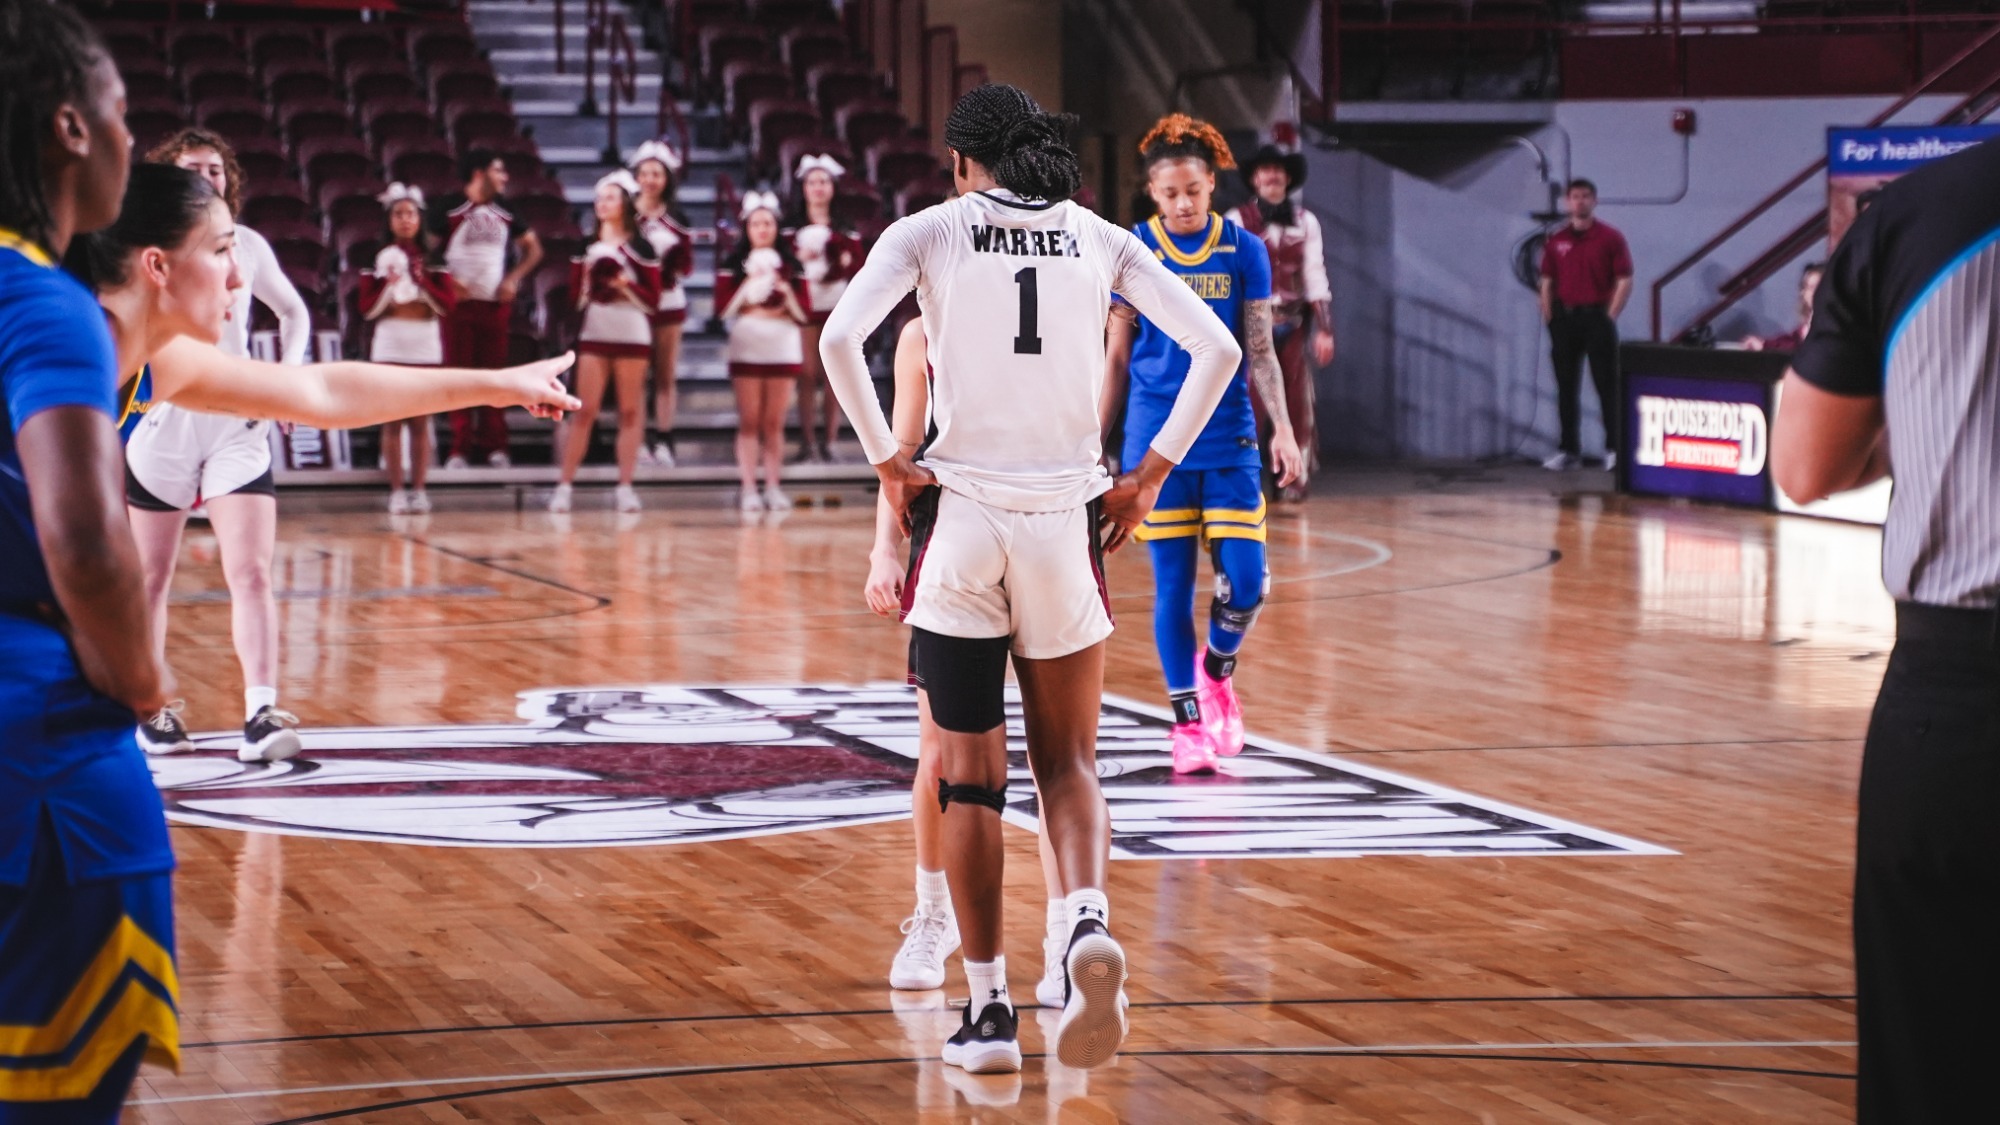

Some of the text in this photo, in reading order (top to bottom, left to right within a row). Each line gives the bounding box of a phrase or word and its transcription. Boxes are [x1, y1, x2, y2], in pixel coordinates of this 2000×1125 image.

[1841, 139, 1878, 161] For
[1014, 267, 1042, 355] 1
[1636, 395, 1767, 476] HOUSEHOLD
[1667, 441, 1739, 468] FURNITURE
